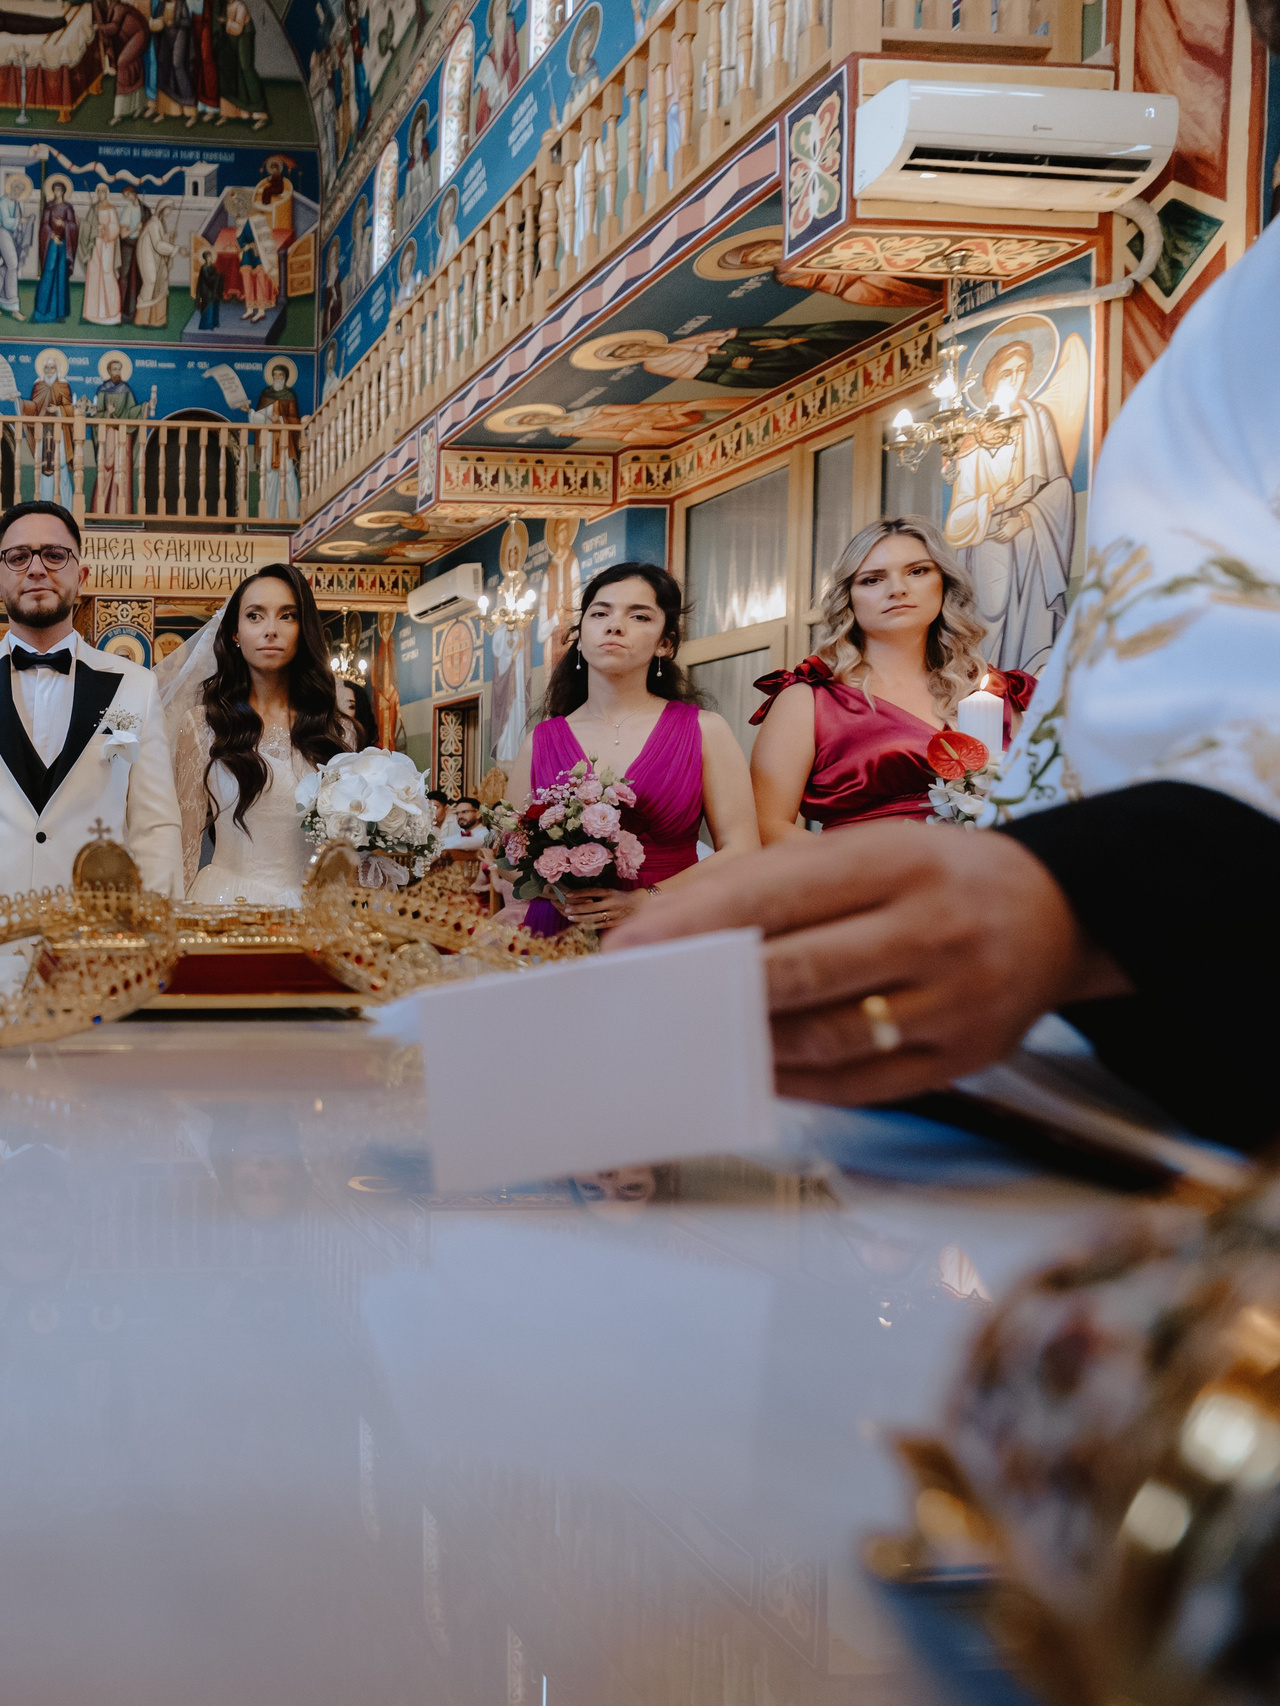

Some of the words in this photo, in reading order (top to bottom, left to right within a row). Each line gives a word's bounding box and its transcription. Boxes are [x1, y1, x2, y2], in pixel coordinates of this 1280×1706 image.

[80, 537, 135, 560] AREA
[86, 564, 133, 589] INTI
[144, 565, 161, 590] AI
